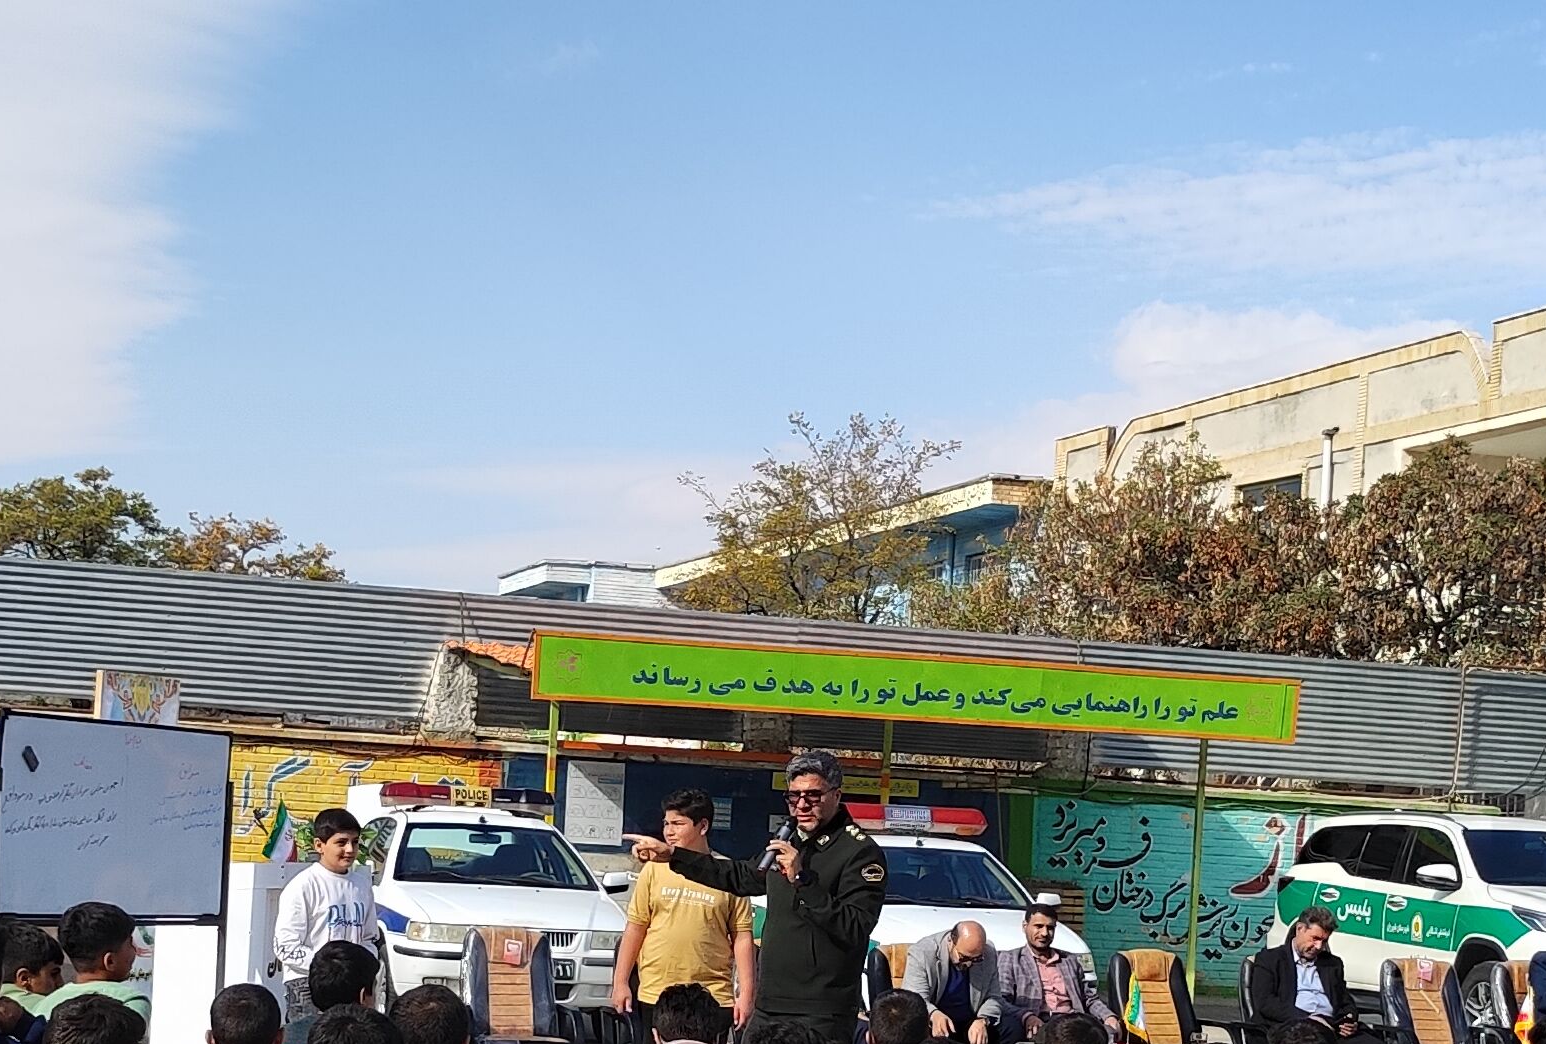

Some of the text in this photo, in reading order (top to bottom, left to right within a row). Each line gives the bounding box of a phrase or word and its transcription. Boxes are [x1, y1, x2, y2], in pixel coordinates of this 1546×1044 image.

[752, 668, 815, 695] هدف
[821, 678, 843, 698] به
[851, 679, 870, 703] را
[877, 678, 897, 705] تو
[902, 682, 953, 707] عمل
[954, 692, 966, 710] و
[1051, 692, 1149, 718] راهنمایی
[1154, 696, 1172, 721] را
[1175, 696, 1198, 722] تو
[1201, 700, 1239, 723] علم
[455, 787, 489, 801] POLICE
[1337, 898, 1373, 925] پلیس
